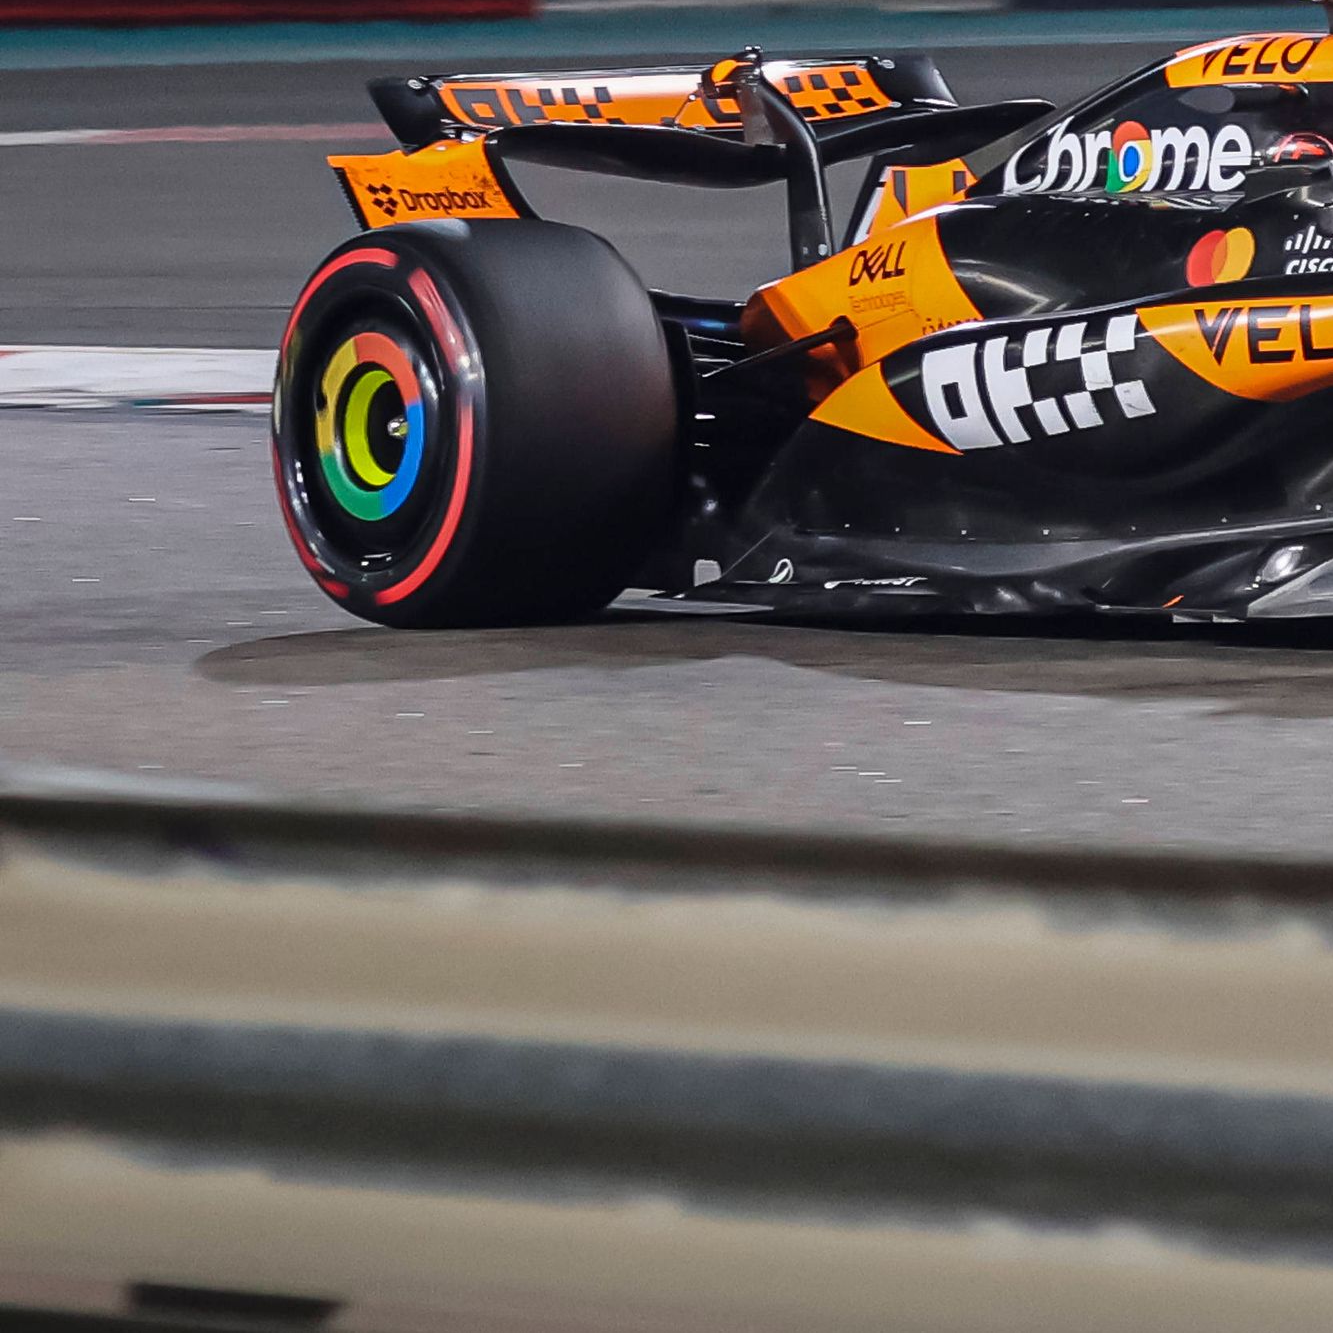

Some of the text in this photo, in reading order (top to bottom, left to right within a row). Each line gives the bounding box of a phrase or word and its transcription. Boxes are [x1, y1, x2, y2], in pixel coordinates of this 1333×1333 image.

[1203, 37, 1323, 78] VELO
[398, 187, 493, 216] Dropbox
[849, 240, 906, 287] DELL
